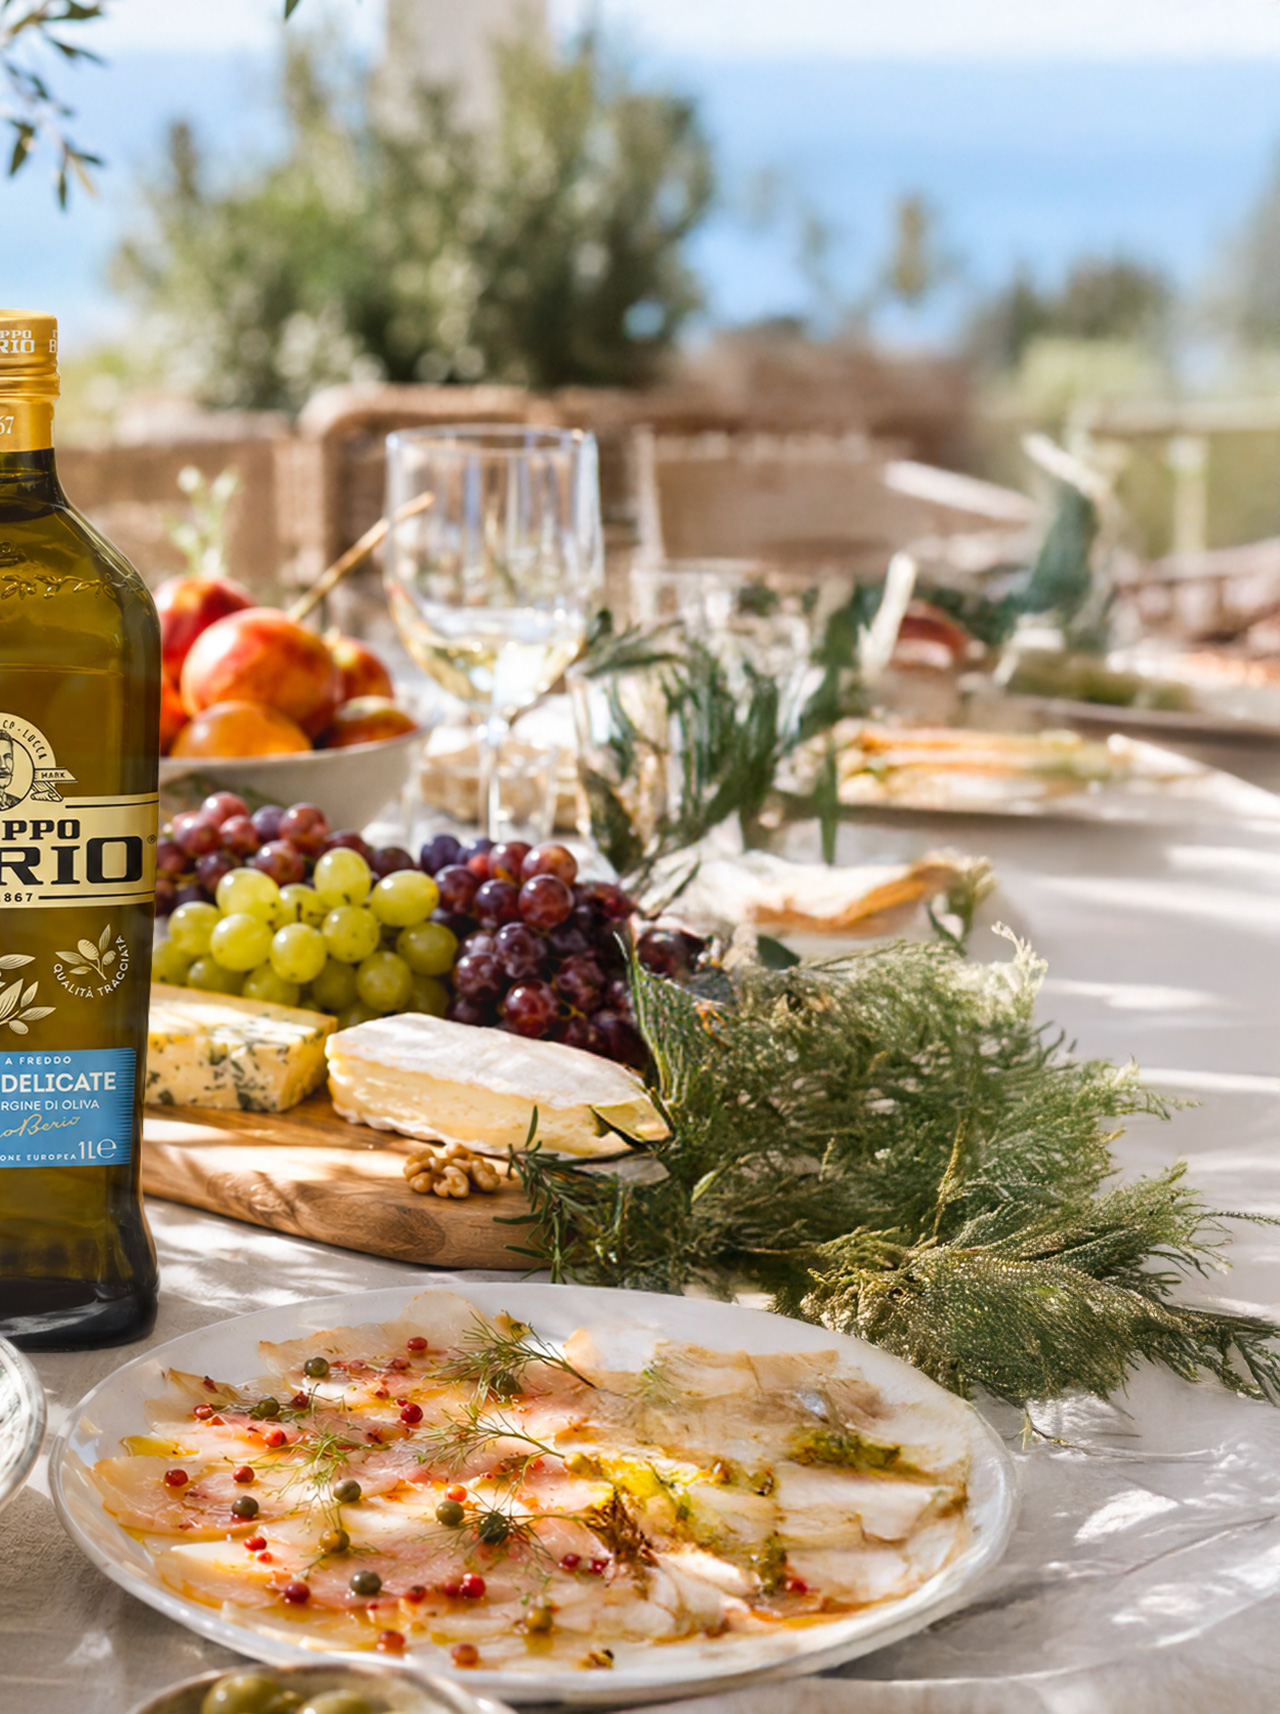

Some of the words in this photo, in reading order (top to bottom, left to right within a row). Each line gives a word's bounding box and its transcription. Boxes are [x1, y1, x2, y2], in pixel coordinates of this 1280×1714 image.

[5, 1057, 13, 1065] A
[19, 1055, 72, 1065] FREDDO
[1, 1071, 117, 1093] DELICATE
[45, 1100, 58, 1111] DI
[61, 1099, 100, 1110] OLIVA
[27, 1153, 77, 1161] EUROPEA
